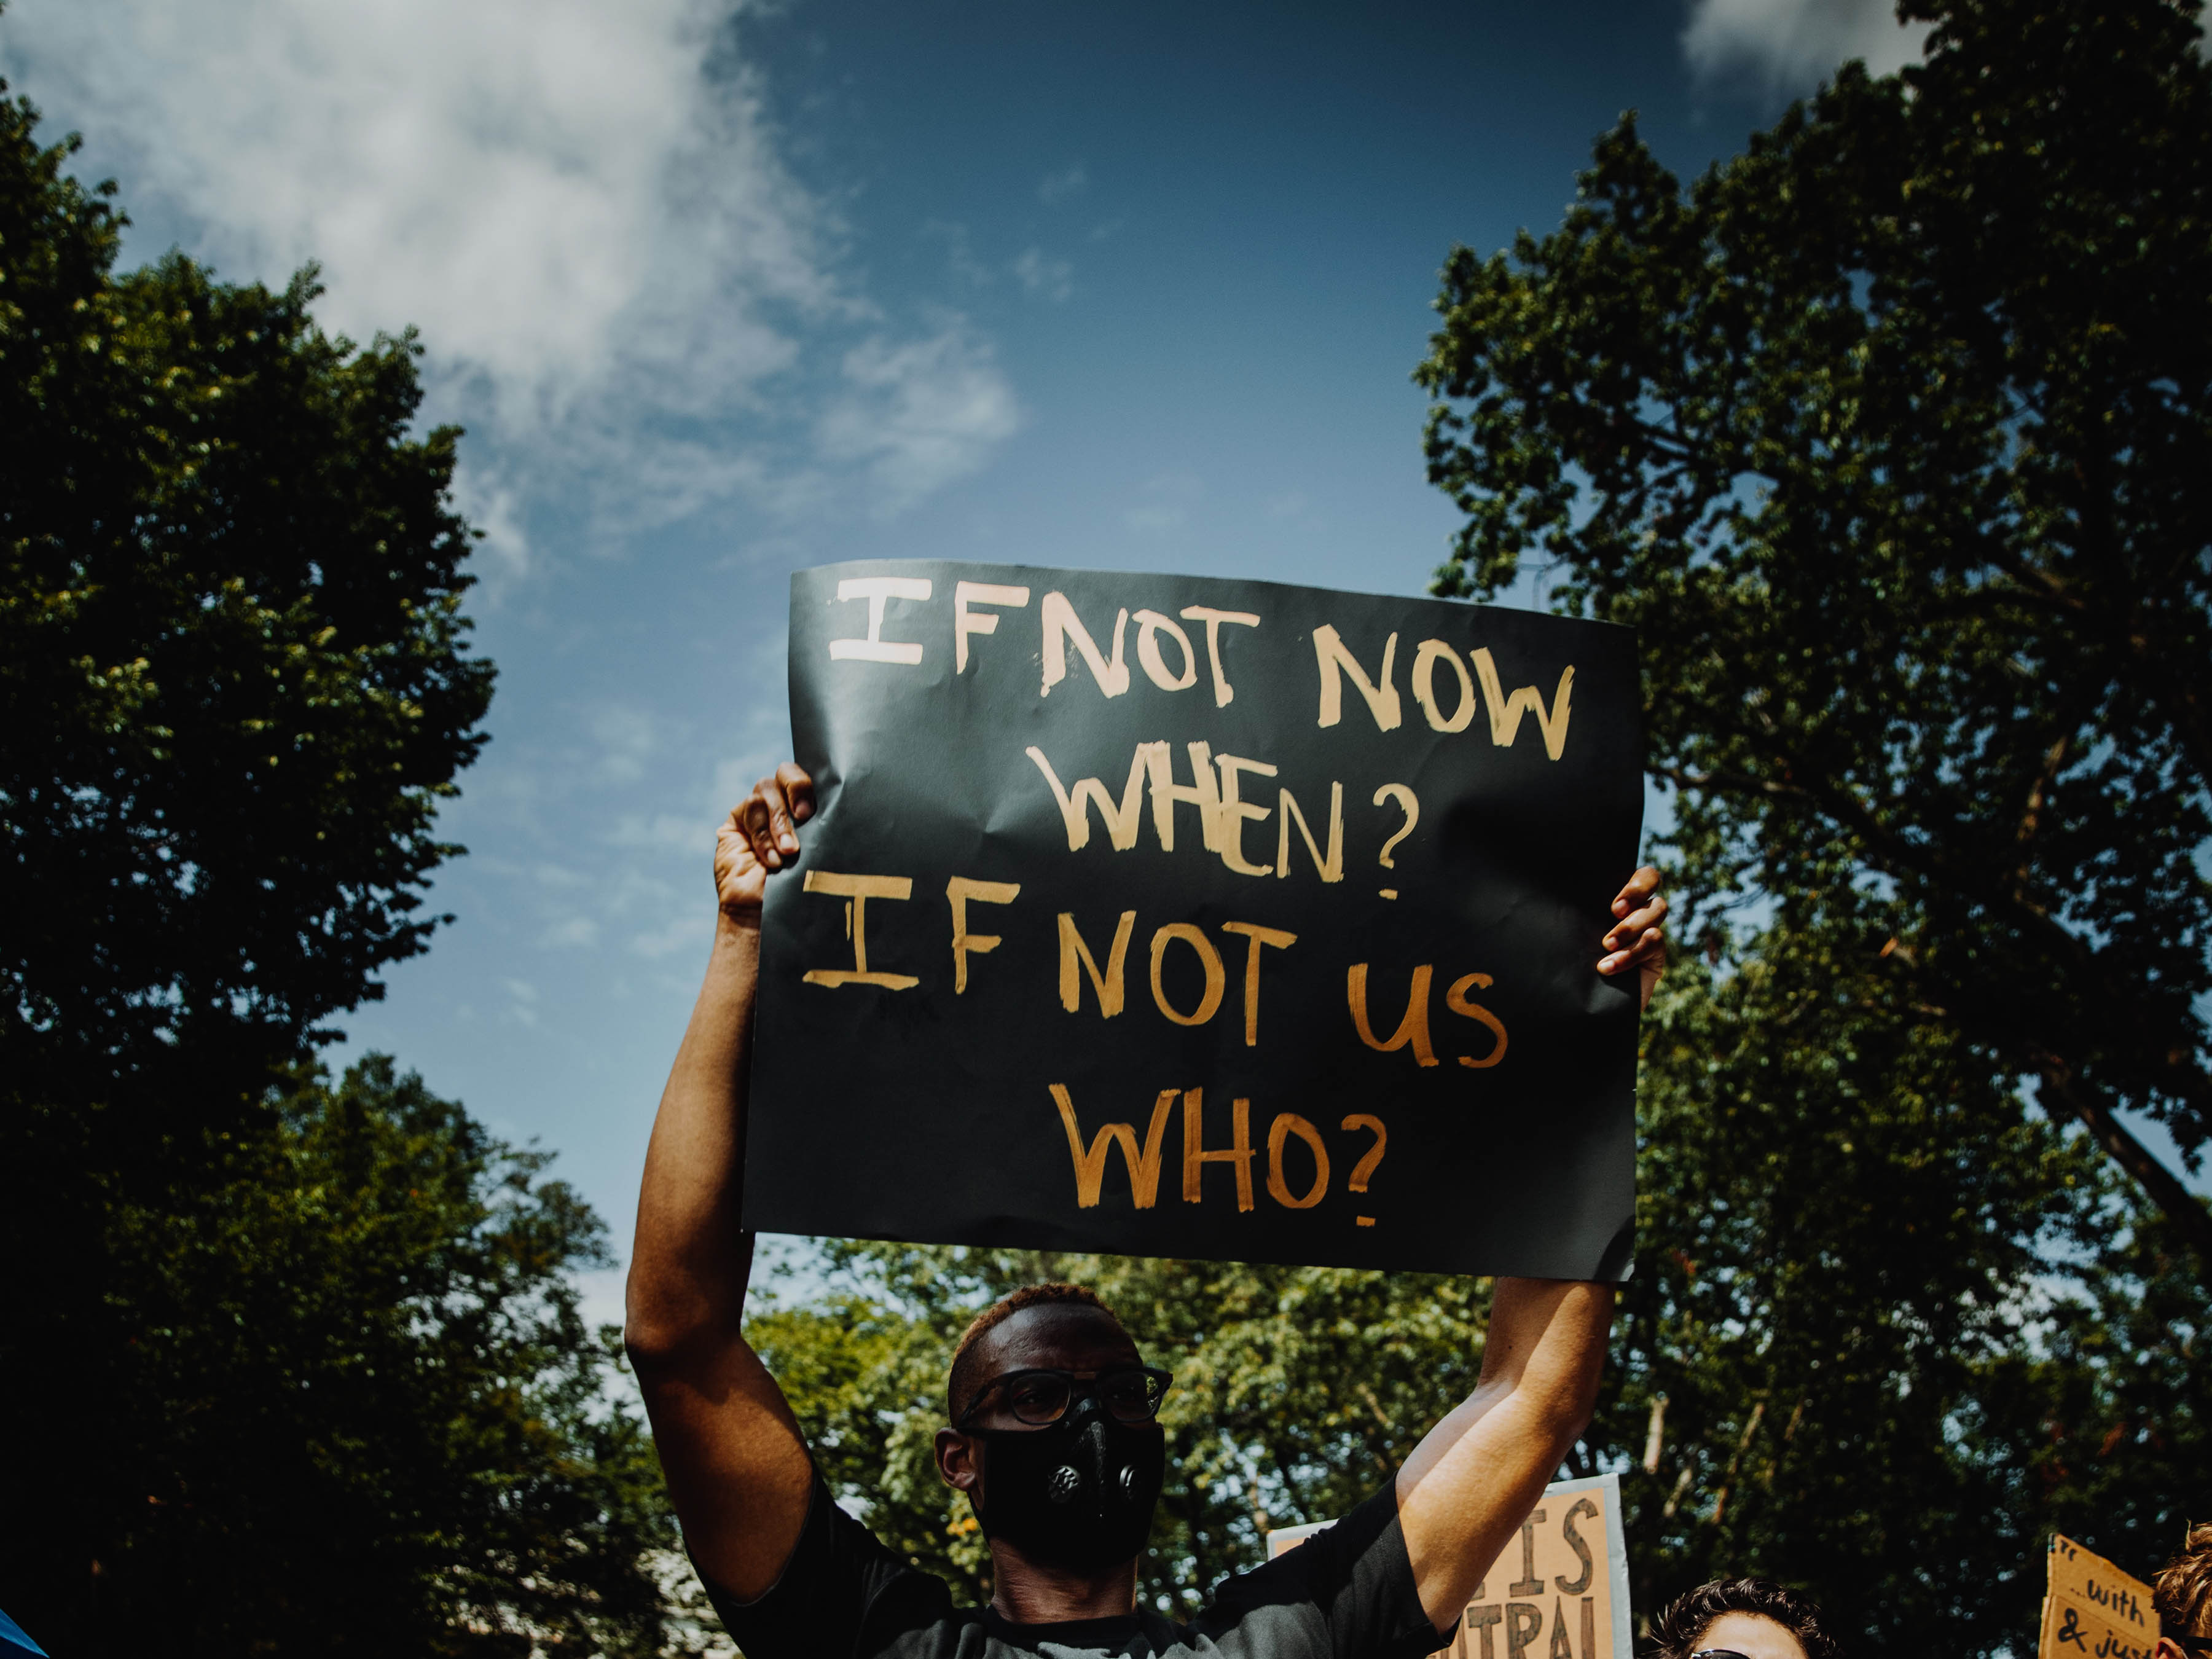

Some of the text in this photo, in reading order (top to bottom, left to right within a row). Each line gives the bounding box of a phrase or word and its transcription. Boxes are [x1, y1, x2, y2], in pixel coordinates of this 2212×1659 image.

[829, 577, 1575, 761] IF NOT NOW
[1026, 741, 1419, 901] WHEN?
[802, 870, 1508, 1068] IF NOT US
[1048, 1083, 1387, 1227] WHO?
[2058, 1607, 2088, 1653] &
